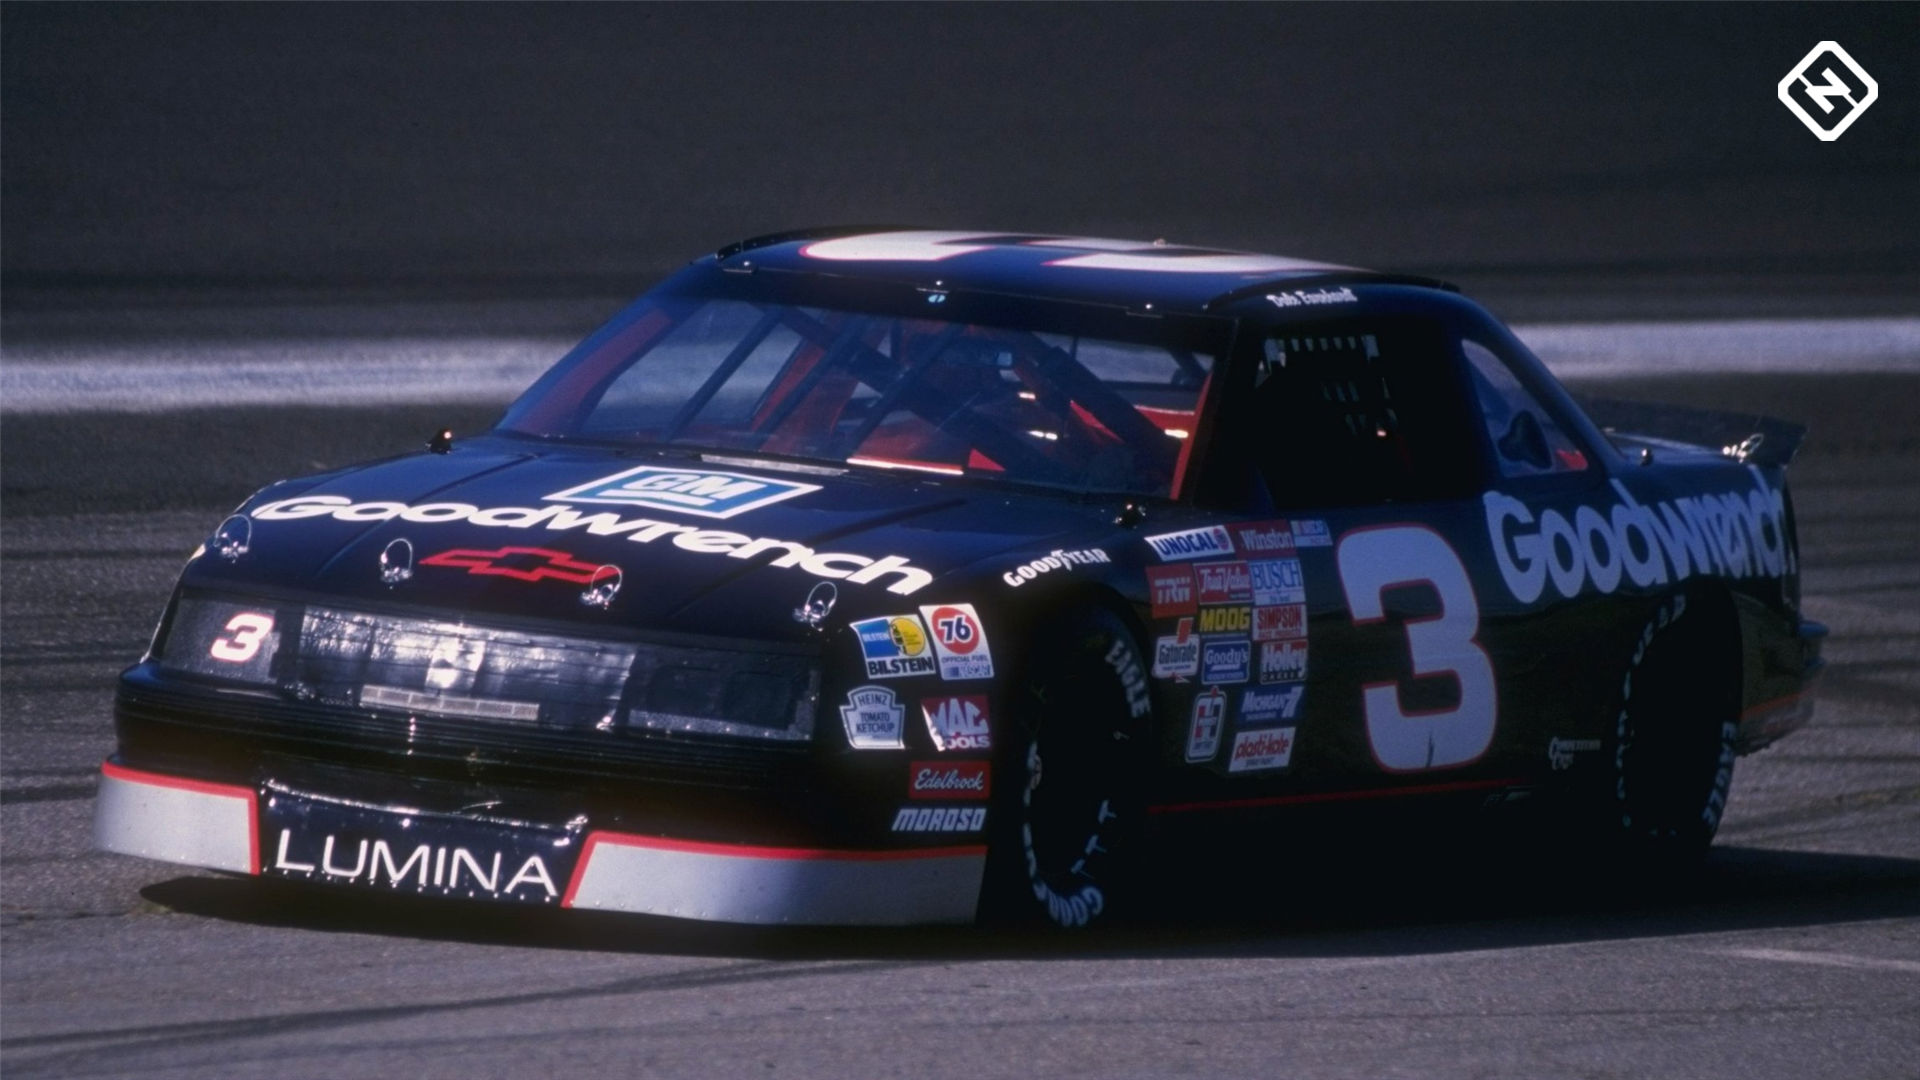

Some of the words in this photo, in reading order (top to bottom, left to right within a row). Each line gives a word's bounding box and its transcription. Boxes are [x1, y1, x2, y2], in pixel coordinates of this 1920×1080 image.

[622, 474, 768, 500] GM
[252, 495, 932, 595] Goodwrench
[1154, 531, 1218, 556] UNOCAL
[1240, 529, 1295, 552] Winston
[1003, 548, 1112, 587] GOODYEAR
[1252, 562, 1302, 590] BUSCH
[1154, 577, 1191, 604] TRW
[939, 617, 972, 644] 76
[1199, 606, 1250, 632] MOOG
[1256, 607, 1303, 630] SIMPSON
[210, 611, 277, 664] 3
[1336, 522, 1498, 774] 3
[868, 656, 935, 676] BILSTEIN
[1159, 643, 1197, 665] Gatorade
[1206, 647, 1249, 665] Goody's
[858, 693, 888, 706] HEINZ
[856, 722, 895, 733] KETCHUP
[860, 711, 891, 722] TOMATO
[929, 698, 988, 737] MAC
[914, 768, 984, 791] Edelbrock
[891, 807, 987, 832] MOROSO
[275, 828, 559, 898] LUMINA
